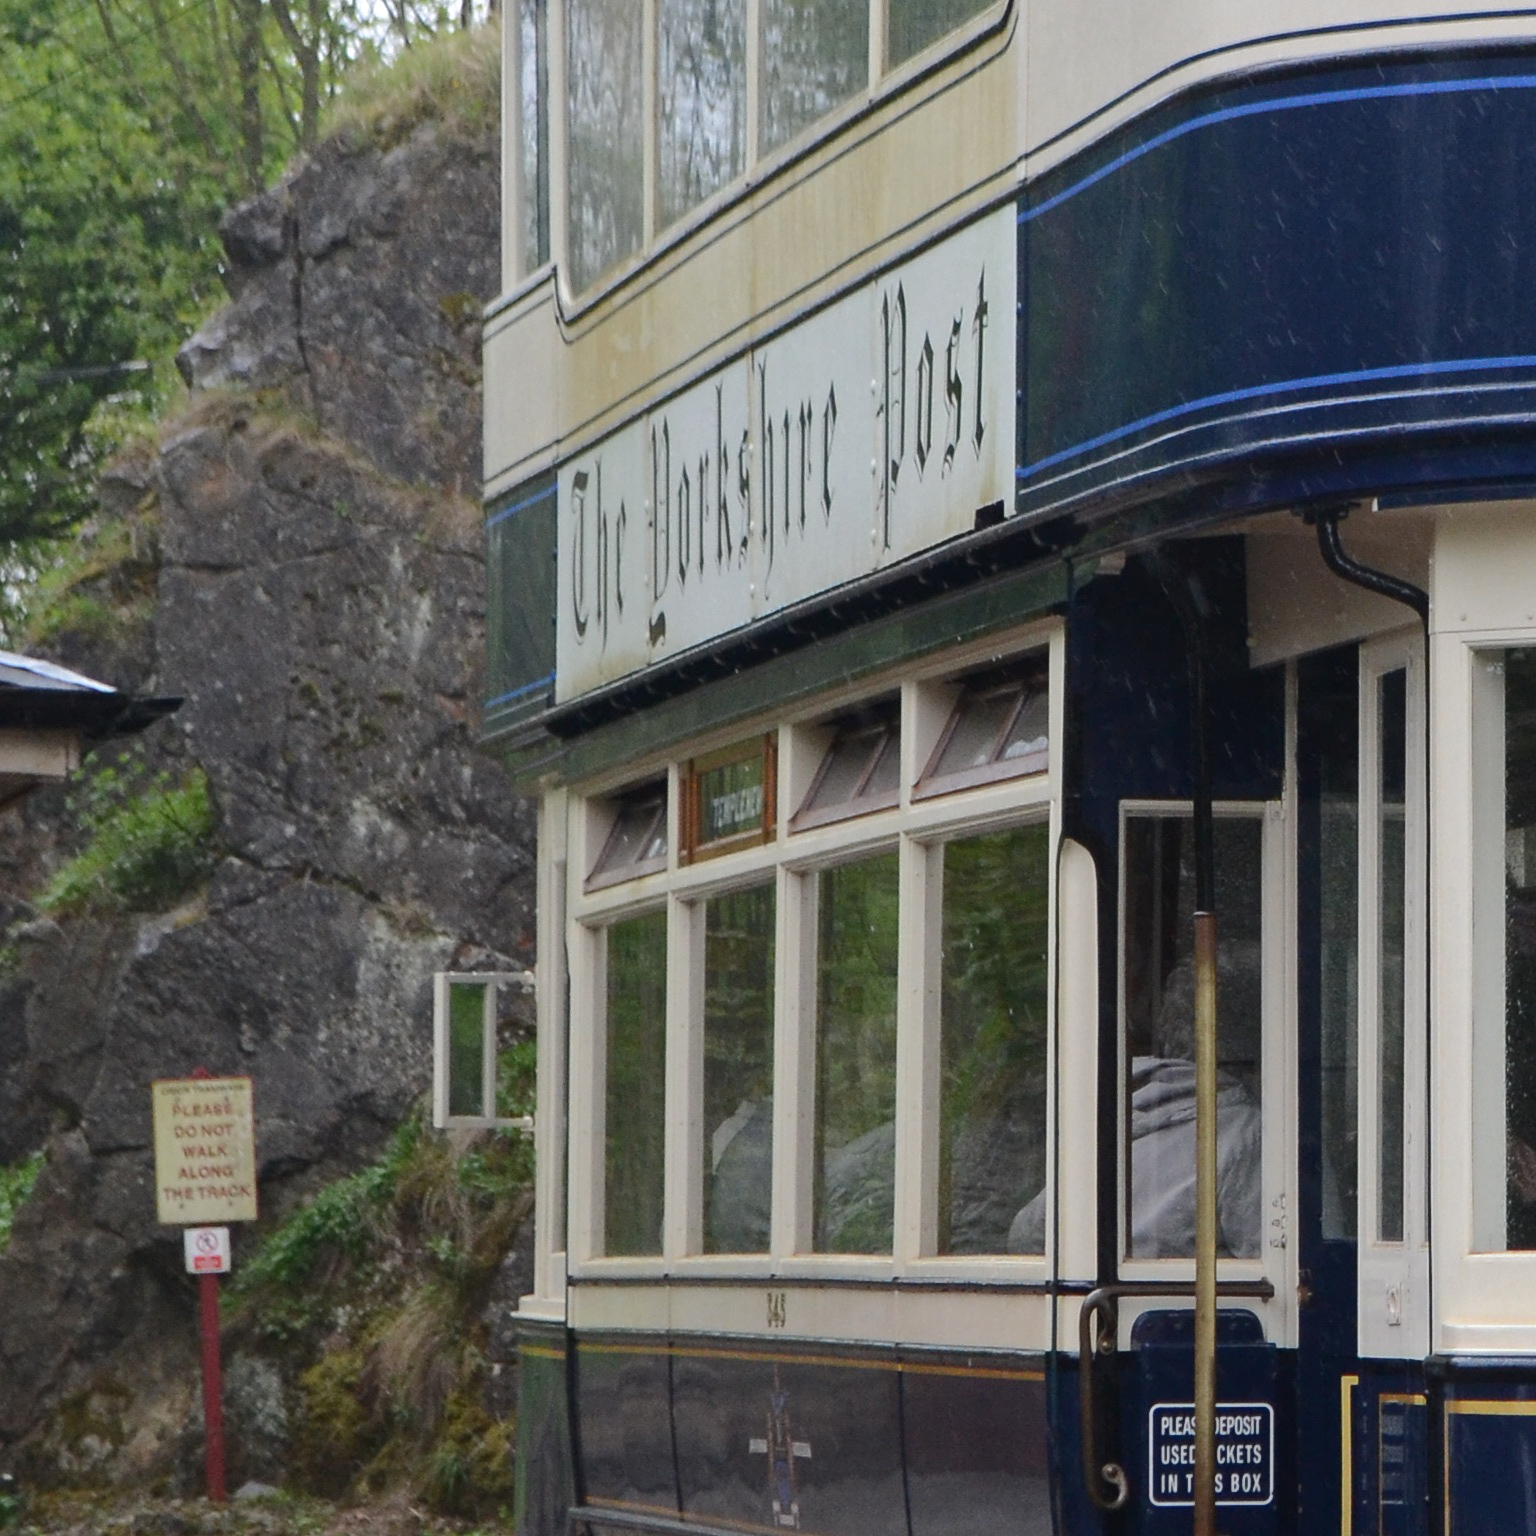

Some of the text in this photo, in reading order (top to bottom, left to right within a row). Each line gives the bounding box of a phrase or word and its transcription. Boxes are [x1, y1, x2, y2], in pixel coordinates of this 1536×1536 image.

[571, 262, 989, 654] The Yorkshire Post
[172, 1102, 234, 1118] PLEASE
[174, 1123, 234, 1139] DO NOT
[182, 1145, 228, 1159] WALK
[178, 1165, 234, 1180] ALONG
[164, 1185, 250, 1202] THE TRACK
[767, 1292, 786, 1328] 345
[1161, 1416, 1196, 1436] PLEAS
[1216, 1444, 1262, 1464] CKETS
[1161, 1473, 1262, 1494] IN TS BOX
